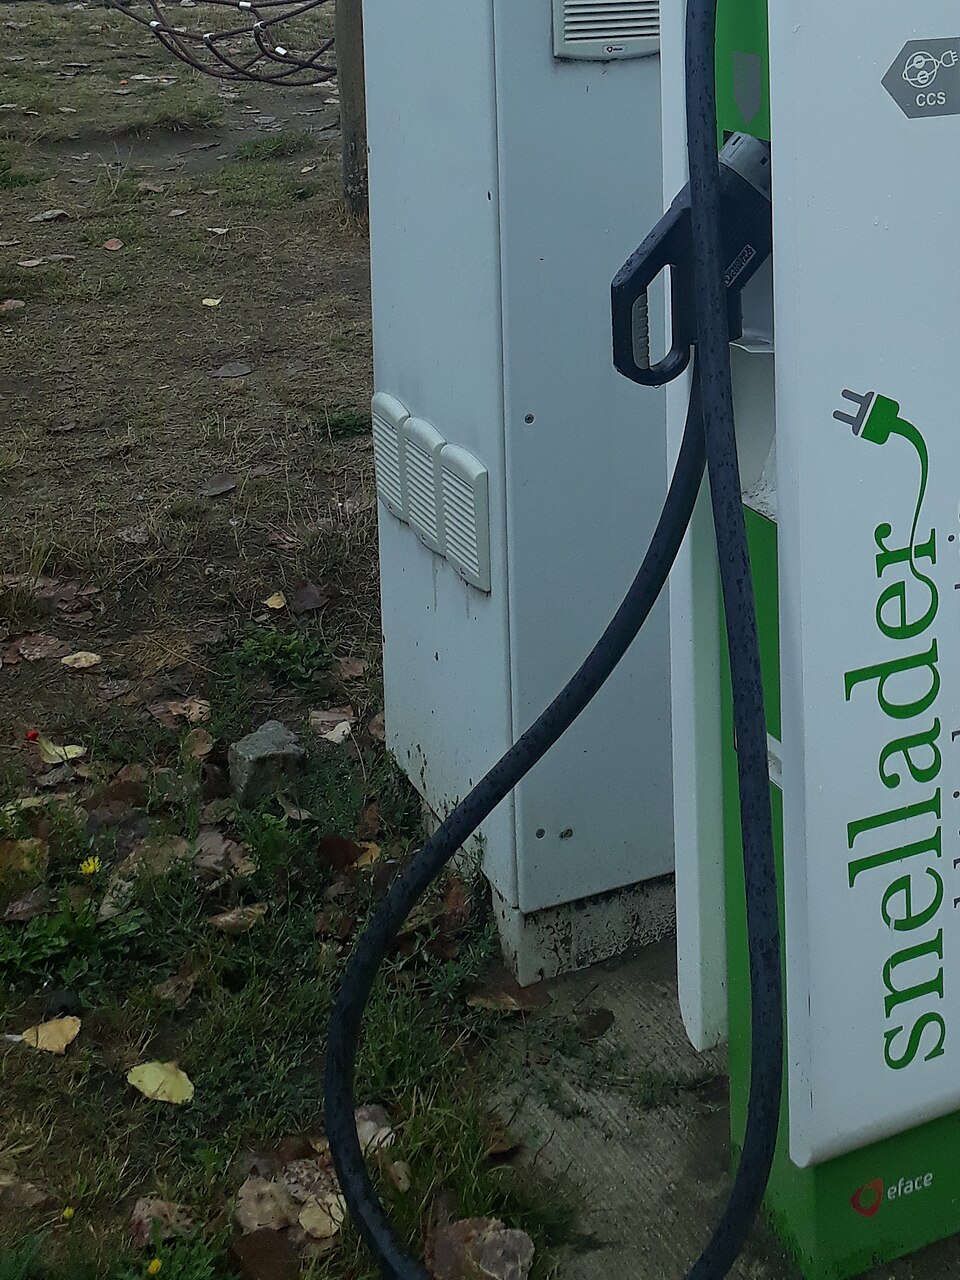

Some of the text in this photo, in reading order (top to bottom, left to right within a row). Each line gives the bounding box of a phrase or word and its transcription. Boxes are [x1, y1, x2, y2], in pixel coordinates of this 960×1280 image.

[916, 92, 946, 107] CCS
[843, 521, 946, 1071] snellader
[887, 1172, 933, 1200] eface
